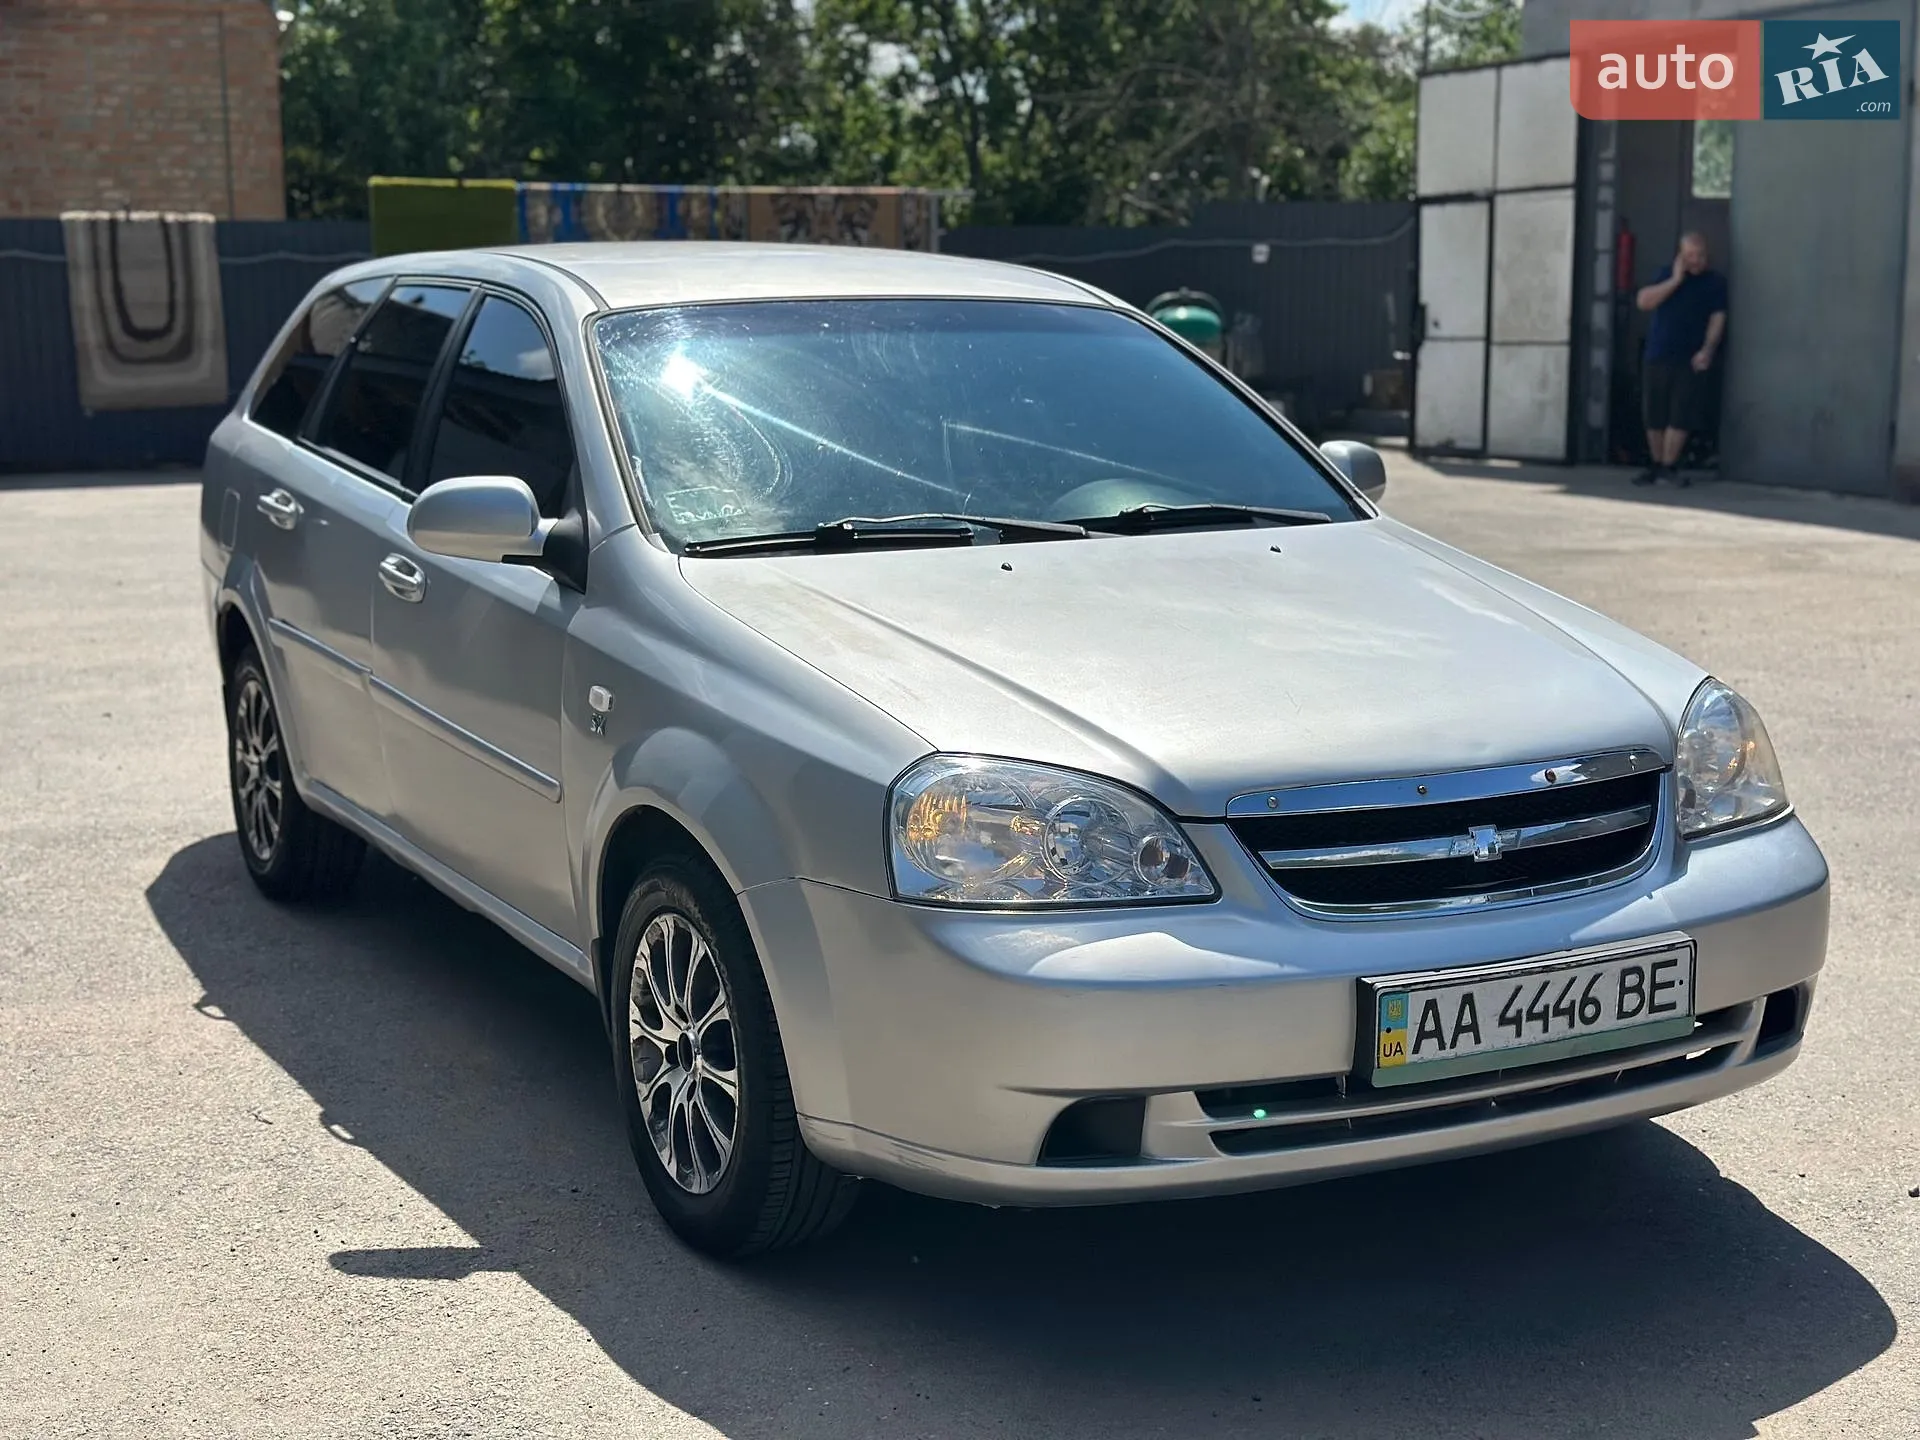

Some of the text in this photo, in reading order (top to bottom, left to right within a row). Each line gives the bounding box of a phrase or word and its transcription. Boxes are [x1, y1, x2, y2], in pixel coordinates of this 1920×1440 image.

[1412, 959, 1679, 1055] AA 4446 BE
[1383, 1041, 1404, 1058] UA
